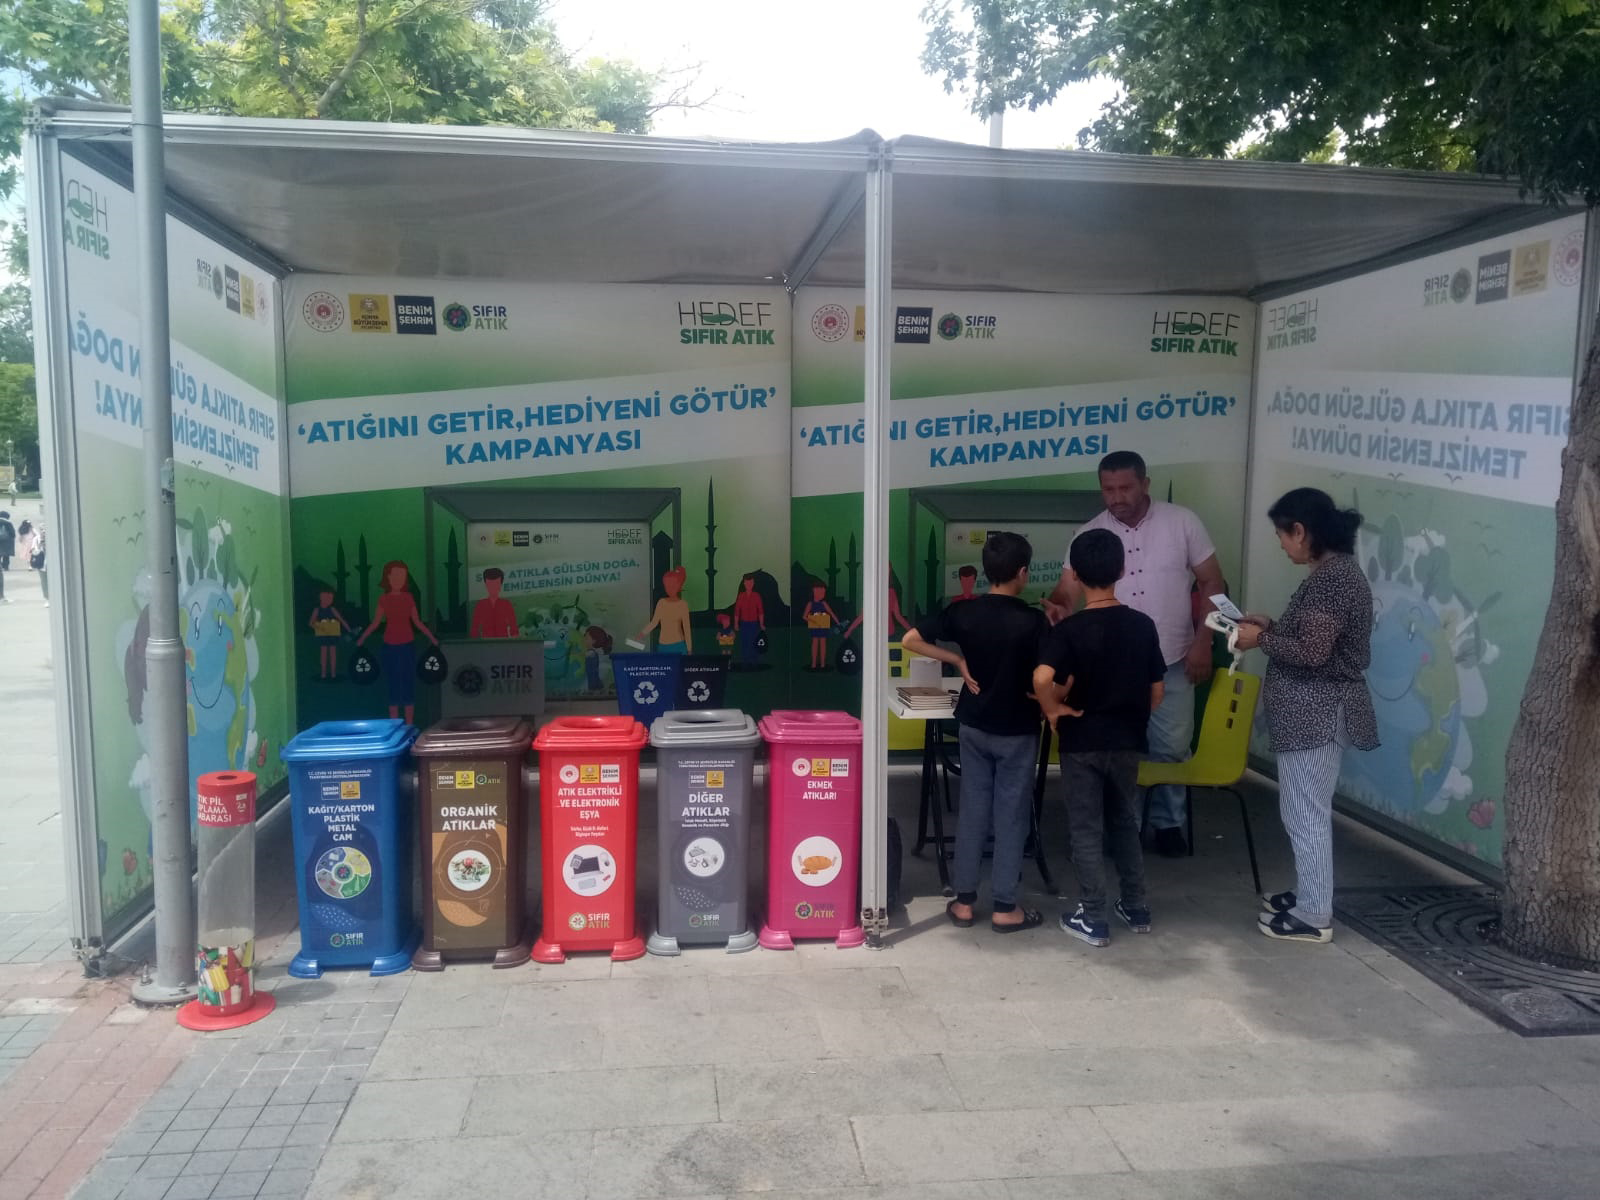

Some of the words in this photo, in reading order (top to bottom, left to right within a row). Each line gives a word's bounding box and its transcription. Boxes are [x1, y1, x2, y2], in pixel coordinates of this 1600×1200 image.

[398, 305, 432, 314] BENİM
[472, 305, 506, 317] SIFIR
[678, 301, 772, 326] HEDEF
[400, 316, 434, 326] ŞEHRİM
[474, 318, 508, 330] ATIK
[898, 316, 930, 326] BENİM
[965, 316, 996, 326] SIFIR
[1152, 312, 1240, 336] HEDEF
[680, 328, 728, 344] SIFIR
[732, 329, 775, 344] ATIK
[897, 326, 928, 335] ŞEHRİM
[964, 328, 996, 338] ATIK
[1150, 338, 1195, 352] SIFIR
[1198, 338, 1238, 357] ATIK
[445, 429, 642, 466] KAMPANYASI
[929, 434, 1108, 468] KAMPANYASI
[508, 567, 550, 579] ATIKLA
[553, 562, 600, 574] GÜLSÜN
[503, 575, 573, 592] EMİZLENSİN
[490, 665, 533, 679] SIFIR
[558, 788, 576, 796] ATIK
[578, 784, 622, 796] ELEKTRİKLİ
[808, 781, 833, 789] EKMEK
[688, 792, 724, 803] DİĞER
[802, 792, 837, 800] ATIKLARI
[560, 799, 570, 808] VE
[572, 796, 620, 807] ELEKTRONİK
[308, 804, 374, 814] KAĞIT/KARTON
[441, 803, 498, 817] ORGANİK
[682, 806, 730, 816] ATIKLAR
[324, 814, 360, 823] PLASTİK
[580, 810, 600, 820] EŞYA
[328, 824, 356, 832] METAL
[442, 820, 496, 831] ATIKLAR
[588, 913, 610, 921] SIFIR
